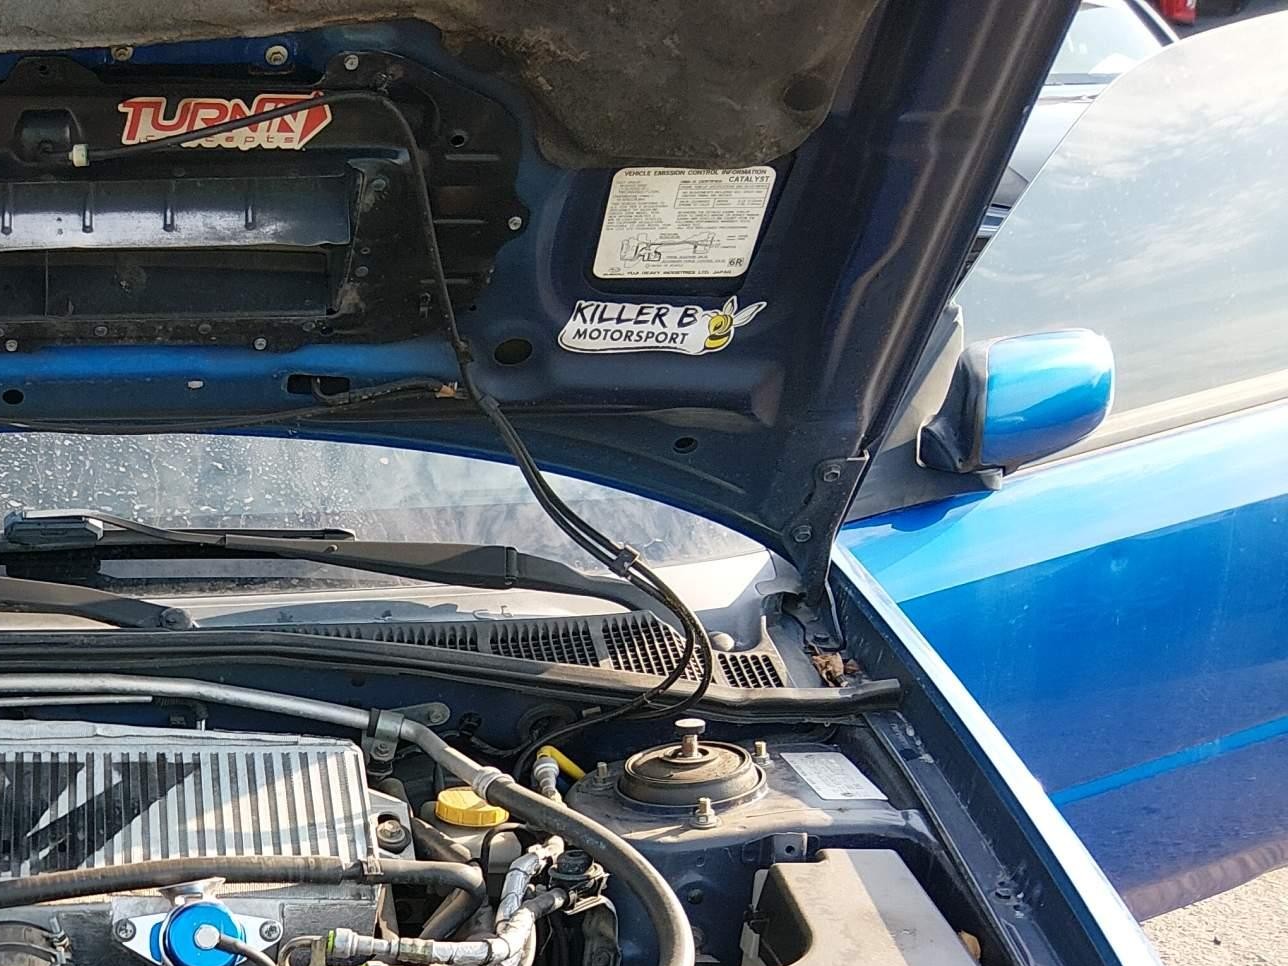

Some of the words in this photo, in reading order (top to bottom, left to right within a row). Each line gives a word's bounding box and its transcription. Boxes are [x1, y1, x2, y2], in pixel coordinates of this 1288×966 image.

[573, 302, 667, 328] KILLER
[677, 307, 698, 328] B
[572, 328, 689, 345] MOTORSPORT
